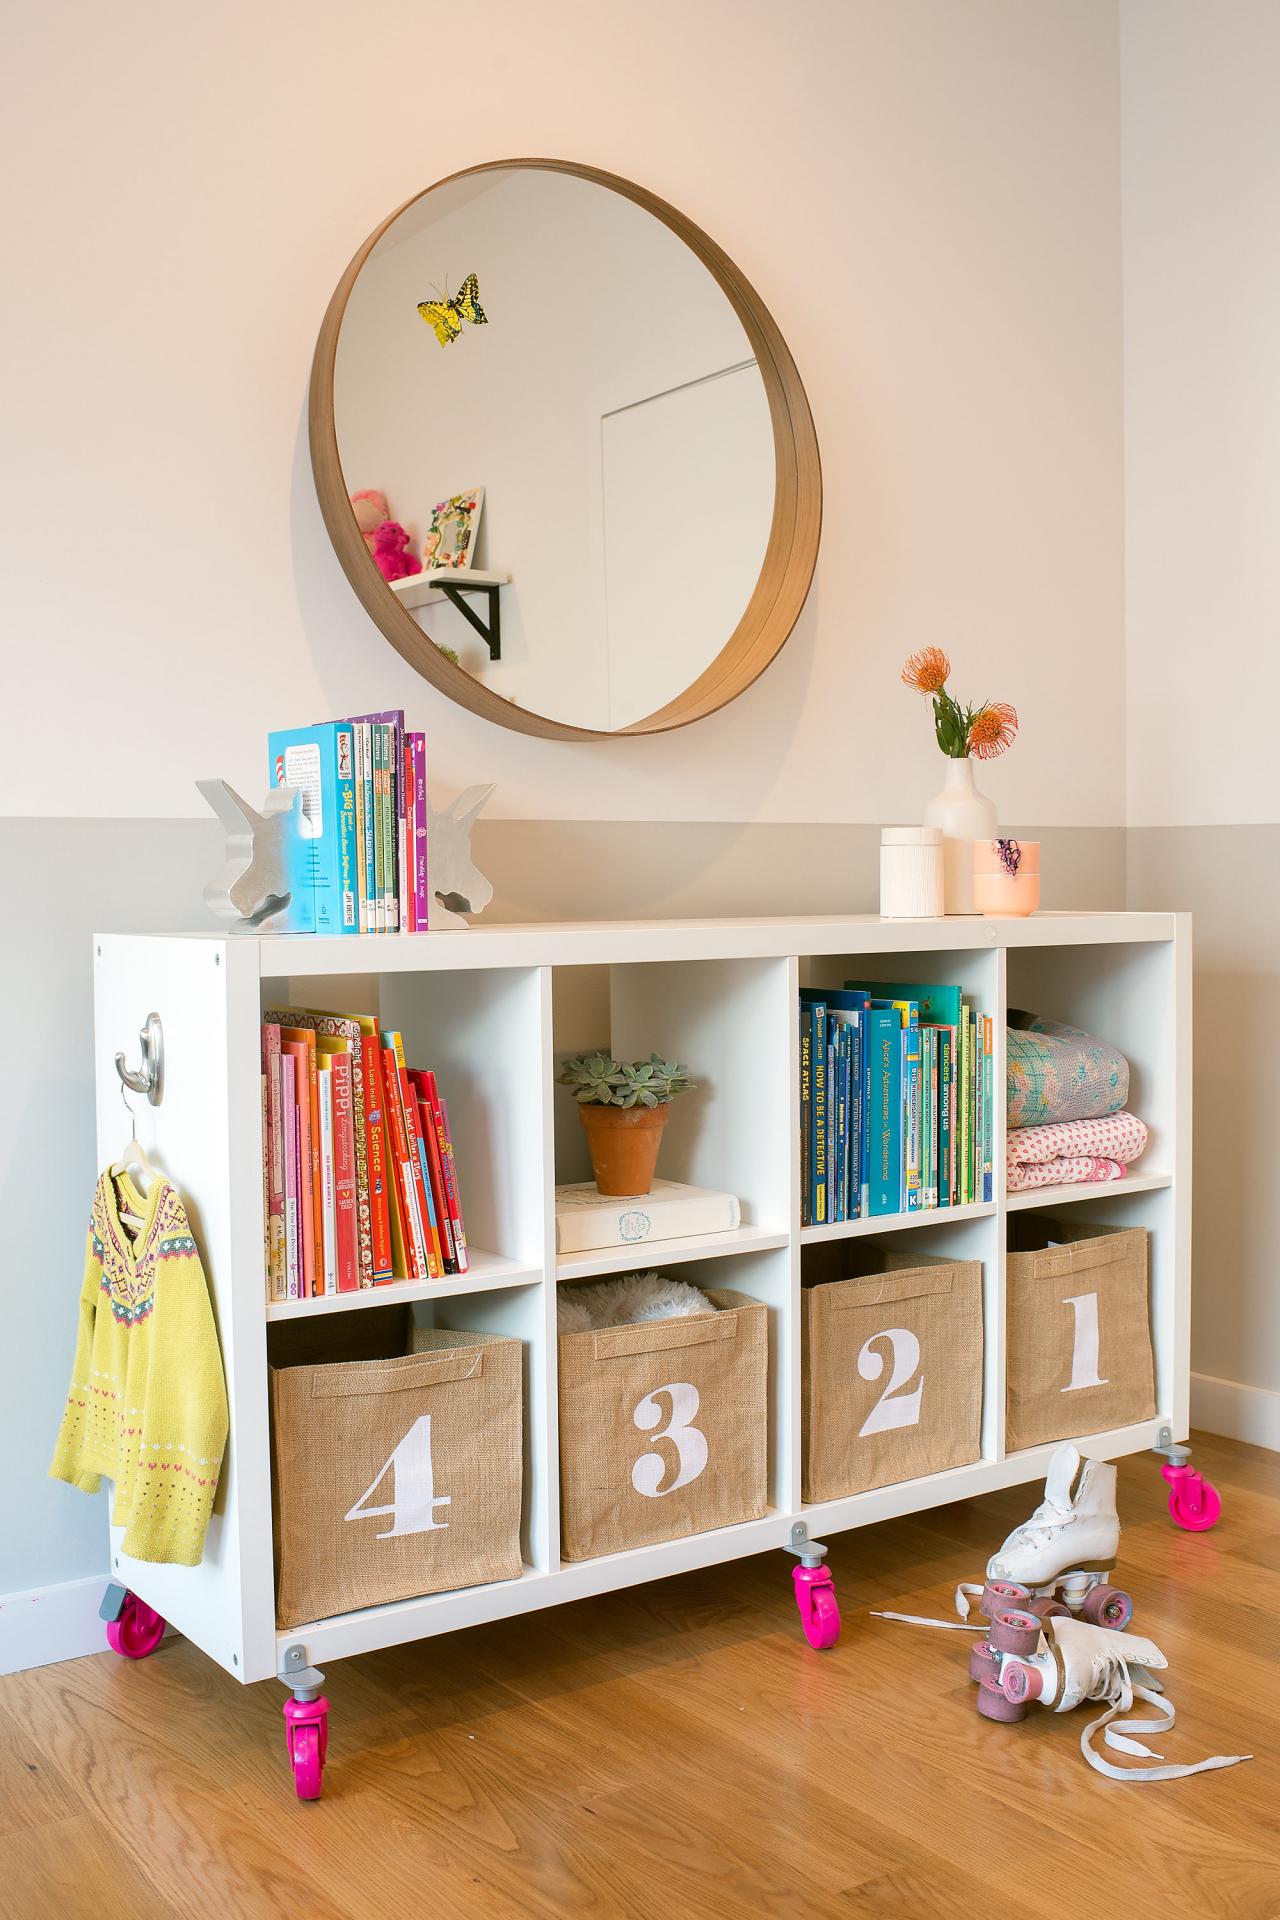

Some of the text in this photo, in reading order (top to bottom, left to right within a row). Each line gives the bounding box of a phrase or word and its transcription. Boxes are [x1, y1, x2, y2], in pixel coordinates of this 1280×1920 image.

[342, 791, 354, 809] BIG
[802, 1036, 810, 1066] SPACE
[882, 1040, 891, 1068] Alice's
[802, 1070, 810, 1101] ATLAS
[816, 1065, 826, 1087] HOW
[370, 1088, 378, 1109] Inside
[816, 1091, 826, 1103] TO
[882, 1070, 890, 1120] Adventures
[941, 1083, 950, 1117] among
[404, 1107, 415, 1131] Rocket
[816, 1106, 826, 1117] BE
[816, 1119, 826, 1127] A
[943, 1118, 949, 1131] us
[338, 1117, 351, 1171] Longstocking
[371, 1126, 383, 1172] Science
[409, 1132, 418, 1154] Writes
[816, 1129, 826, 1176] DETECTIVE
[882, 1129, 892, 1181] Wonderland
[414, 1161, 423, 1180] Story
[910, 1195, 917, 1206] K
[1060, 1292, 1109, 1393] 1
[857, 1328, 925, 1437] 2
[631, 1382, 709, 1498] 3
[344, 1414, 452, 1540] 4
